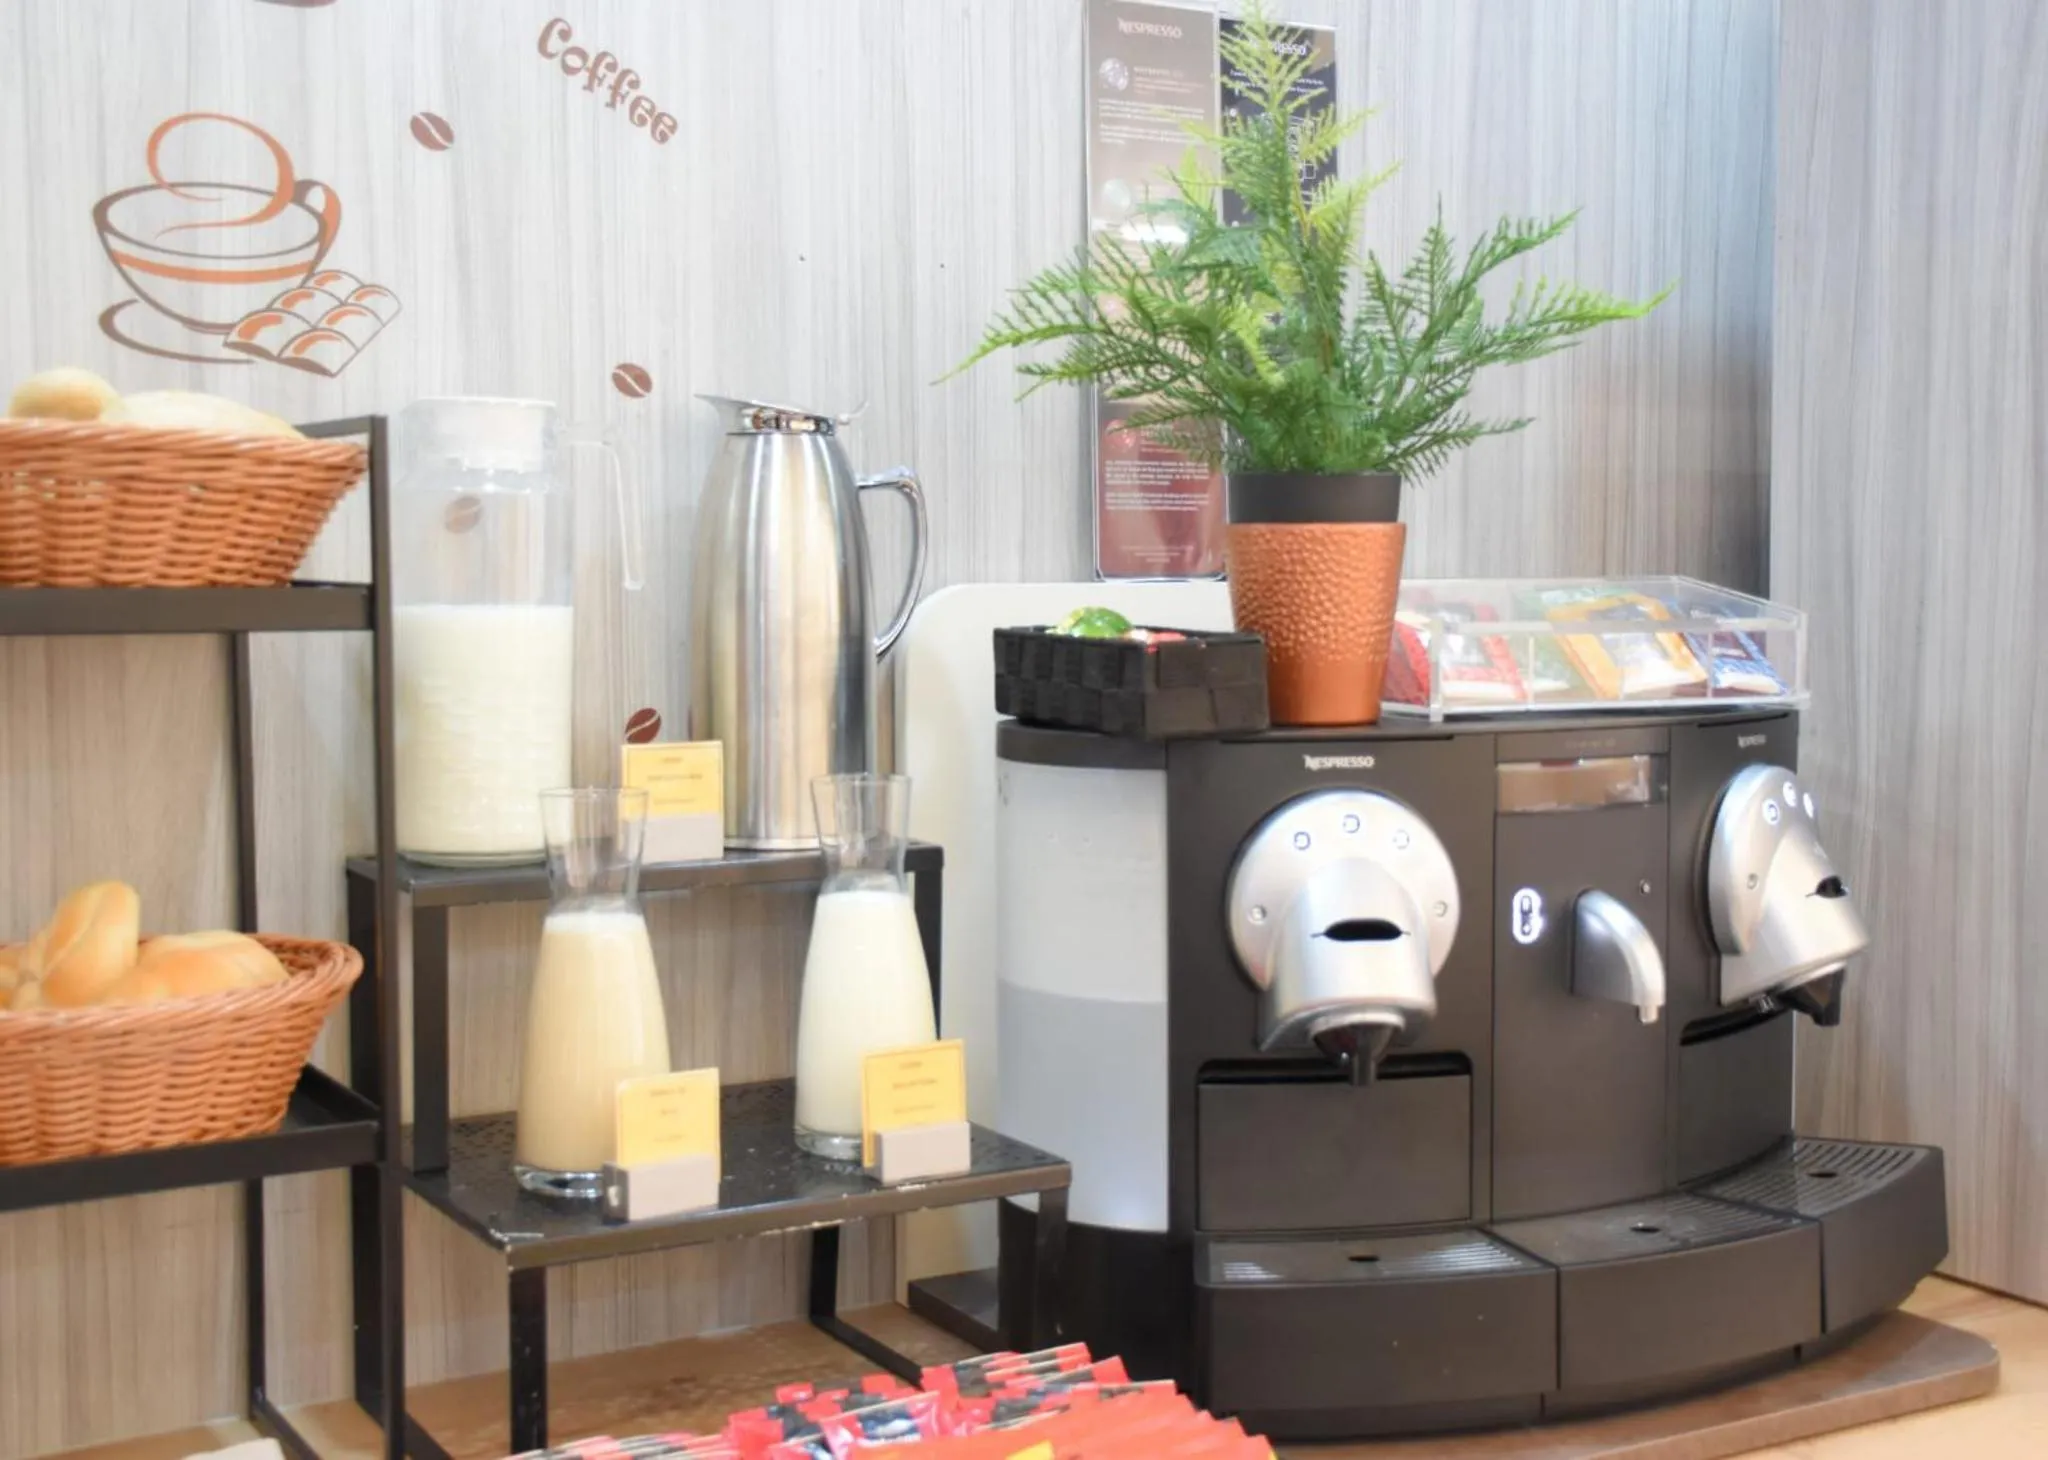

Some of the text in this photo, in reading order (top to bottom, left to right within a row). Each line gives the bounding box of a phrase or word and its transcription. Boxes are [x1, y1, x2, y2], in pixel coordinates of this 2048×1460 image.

[1117, 17, 1183, 40] NESPRESSO
[537, 17, 678, 145] Coffee
[1302, 753, 1375, 771] NESPRESSO
